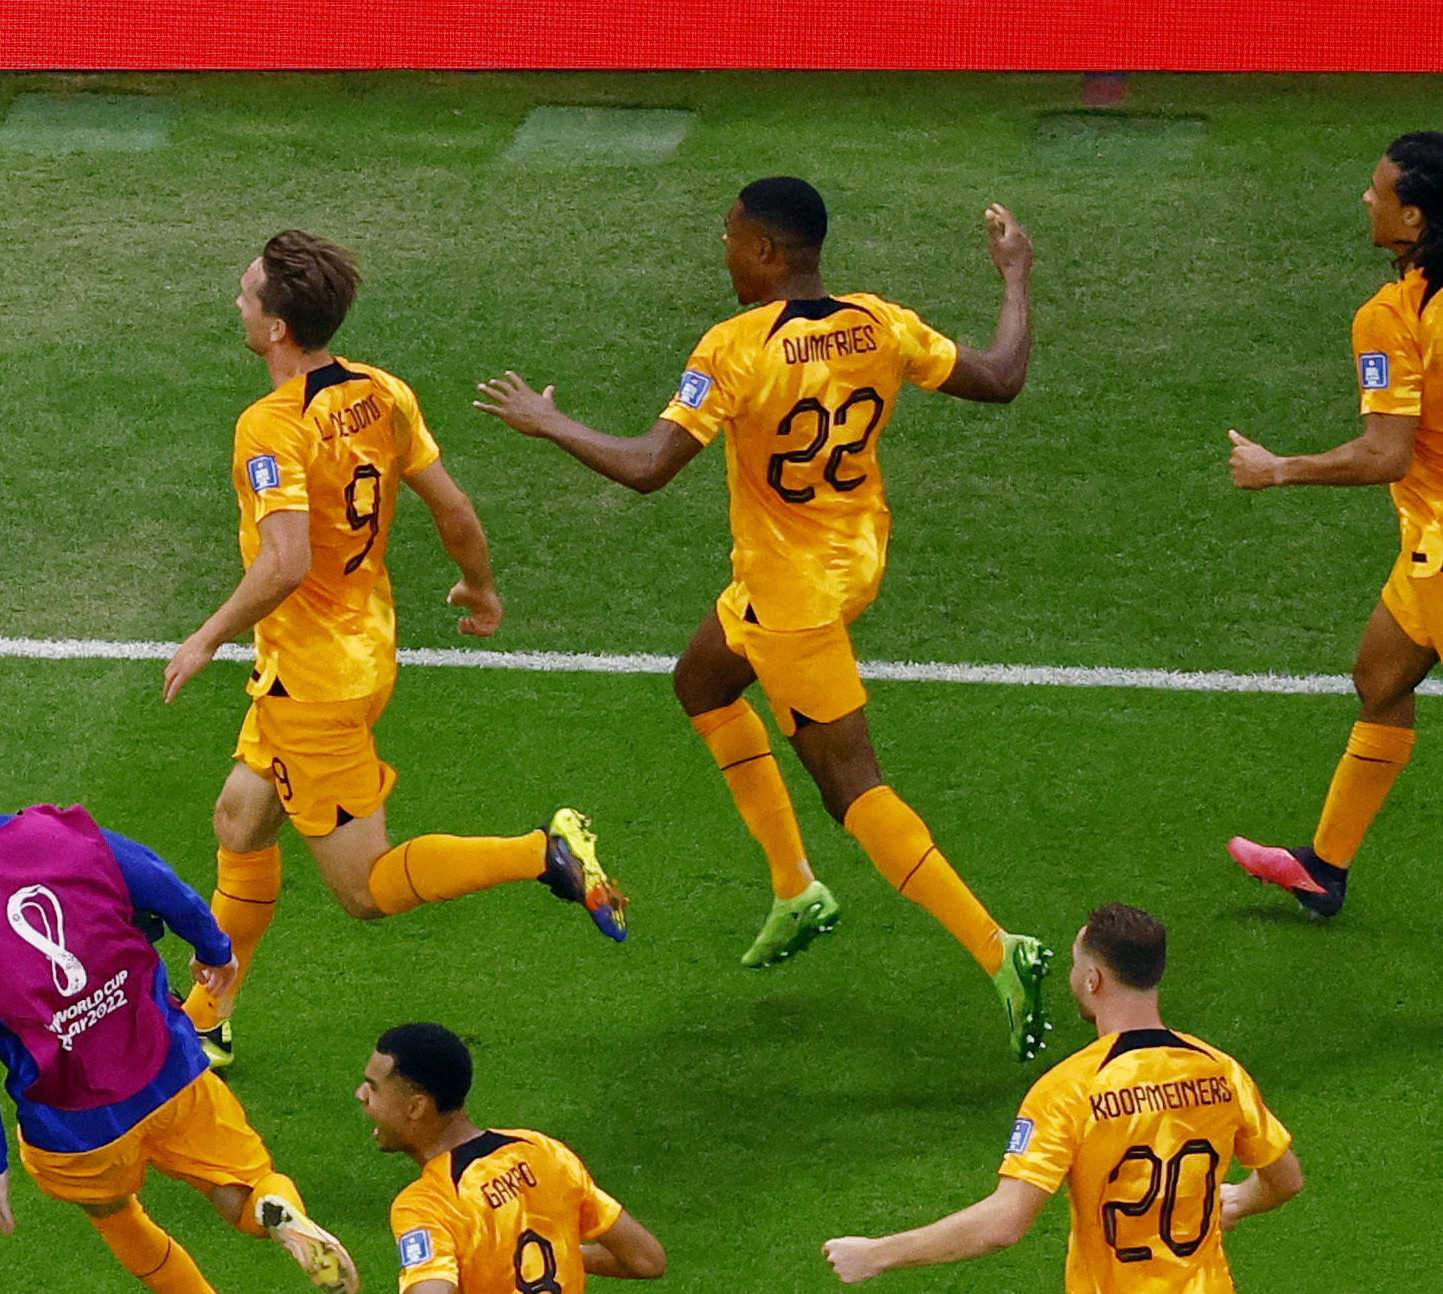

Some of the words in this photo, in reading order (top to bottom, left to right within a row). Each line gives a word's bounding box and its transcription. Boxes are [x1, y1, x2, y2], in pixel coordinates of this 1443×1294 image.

[783, 324, 877, 367] DUMFRIES
[768, 386, 885, 504] 22
[343, 463, 382, 576] 9
[272, 757, 293, 801] 9
[99, 969, 129, 999] CUP
[1091, 1075, 1234, 1123] KOOPMEINERS
[480, 1161, 538, 1210] GAKPO
[1107, 1138, 1220, 1264] 20
